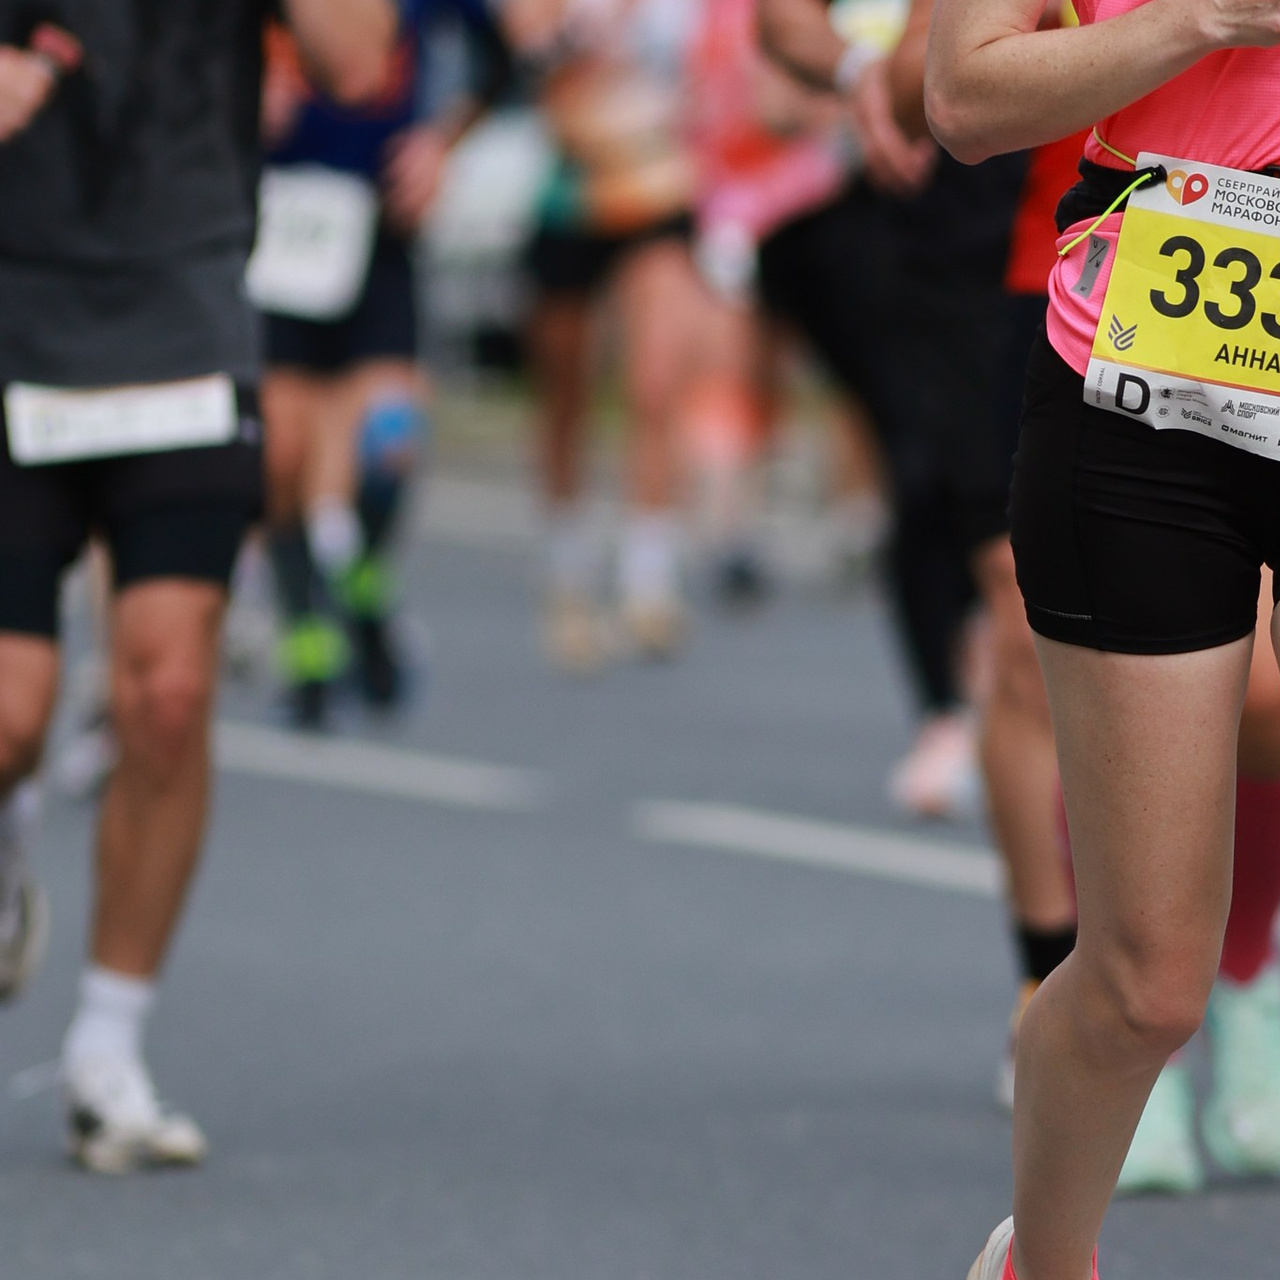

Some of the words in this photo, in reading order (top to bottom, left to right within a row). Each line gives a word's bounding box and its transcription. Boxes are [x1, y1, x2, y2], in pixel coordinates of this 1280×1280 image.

[1214, 343, 1280, 373] АННА
[1115, 372, 1150, 415] D
[1237, 409, 1257, 420] СПОРТ
[1238, 401, 1280, 417] МОСКОВСКИЙ
